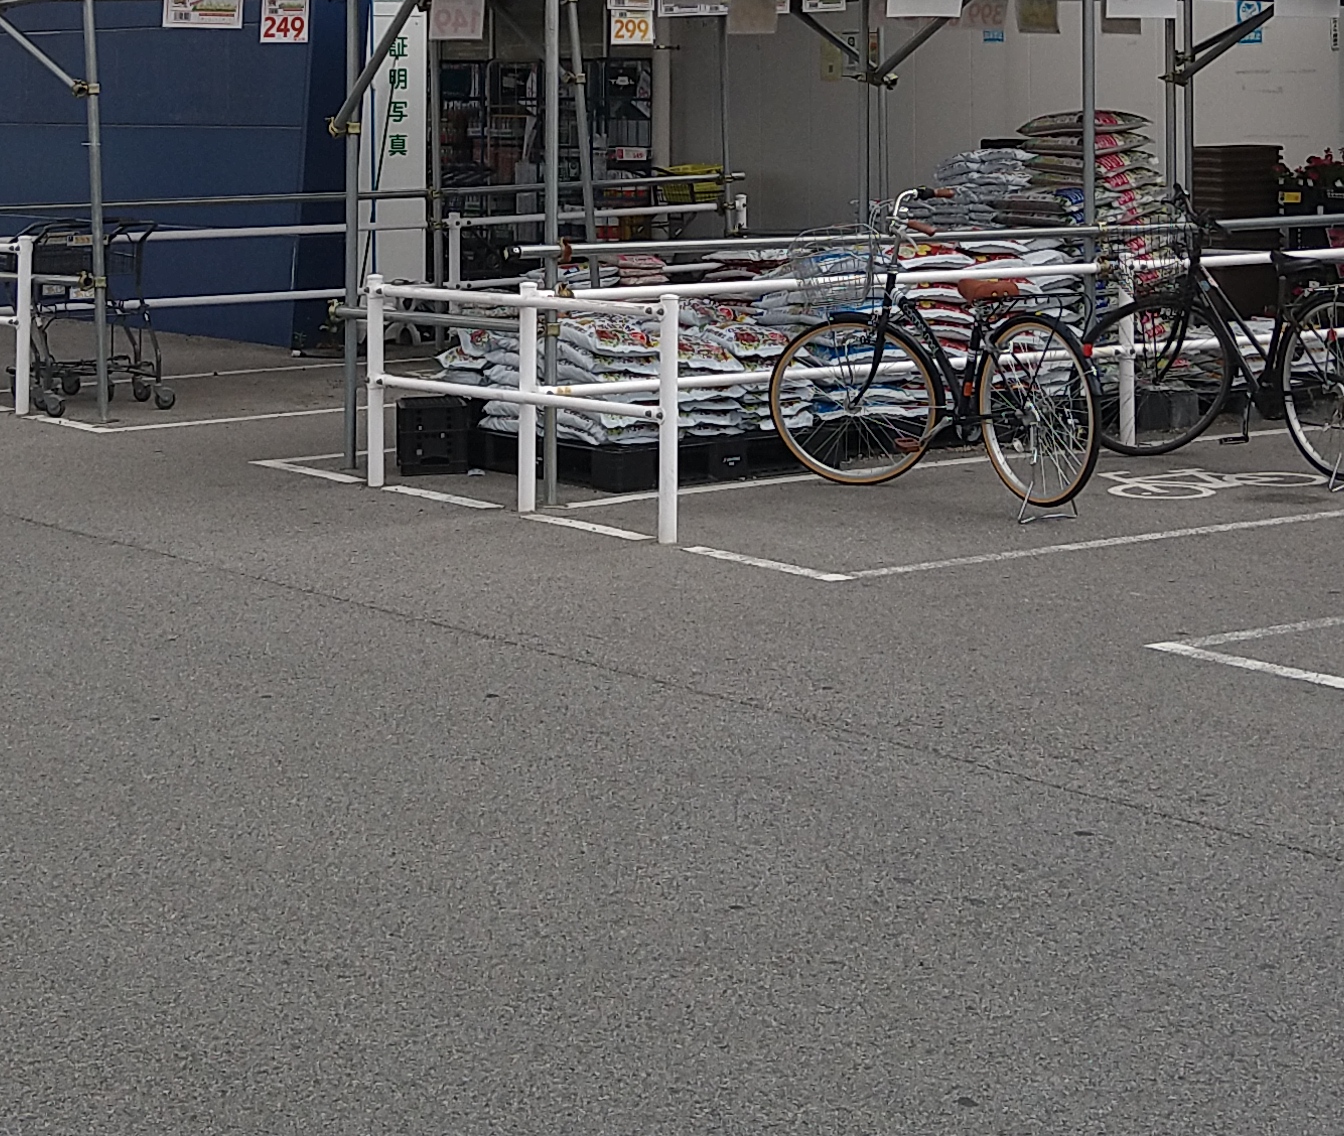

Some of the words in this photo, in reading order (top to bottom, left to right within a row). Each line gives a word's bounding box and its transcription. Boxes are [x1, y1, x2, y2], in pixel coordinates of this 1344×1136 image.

[263, 16, 305, 38] 249
[614, 19, 649, 41] 299
[389, 36, 409, 156] 証明写真
